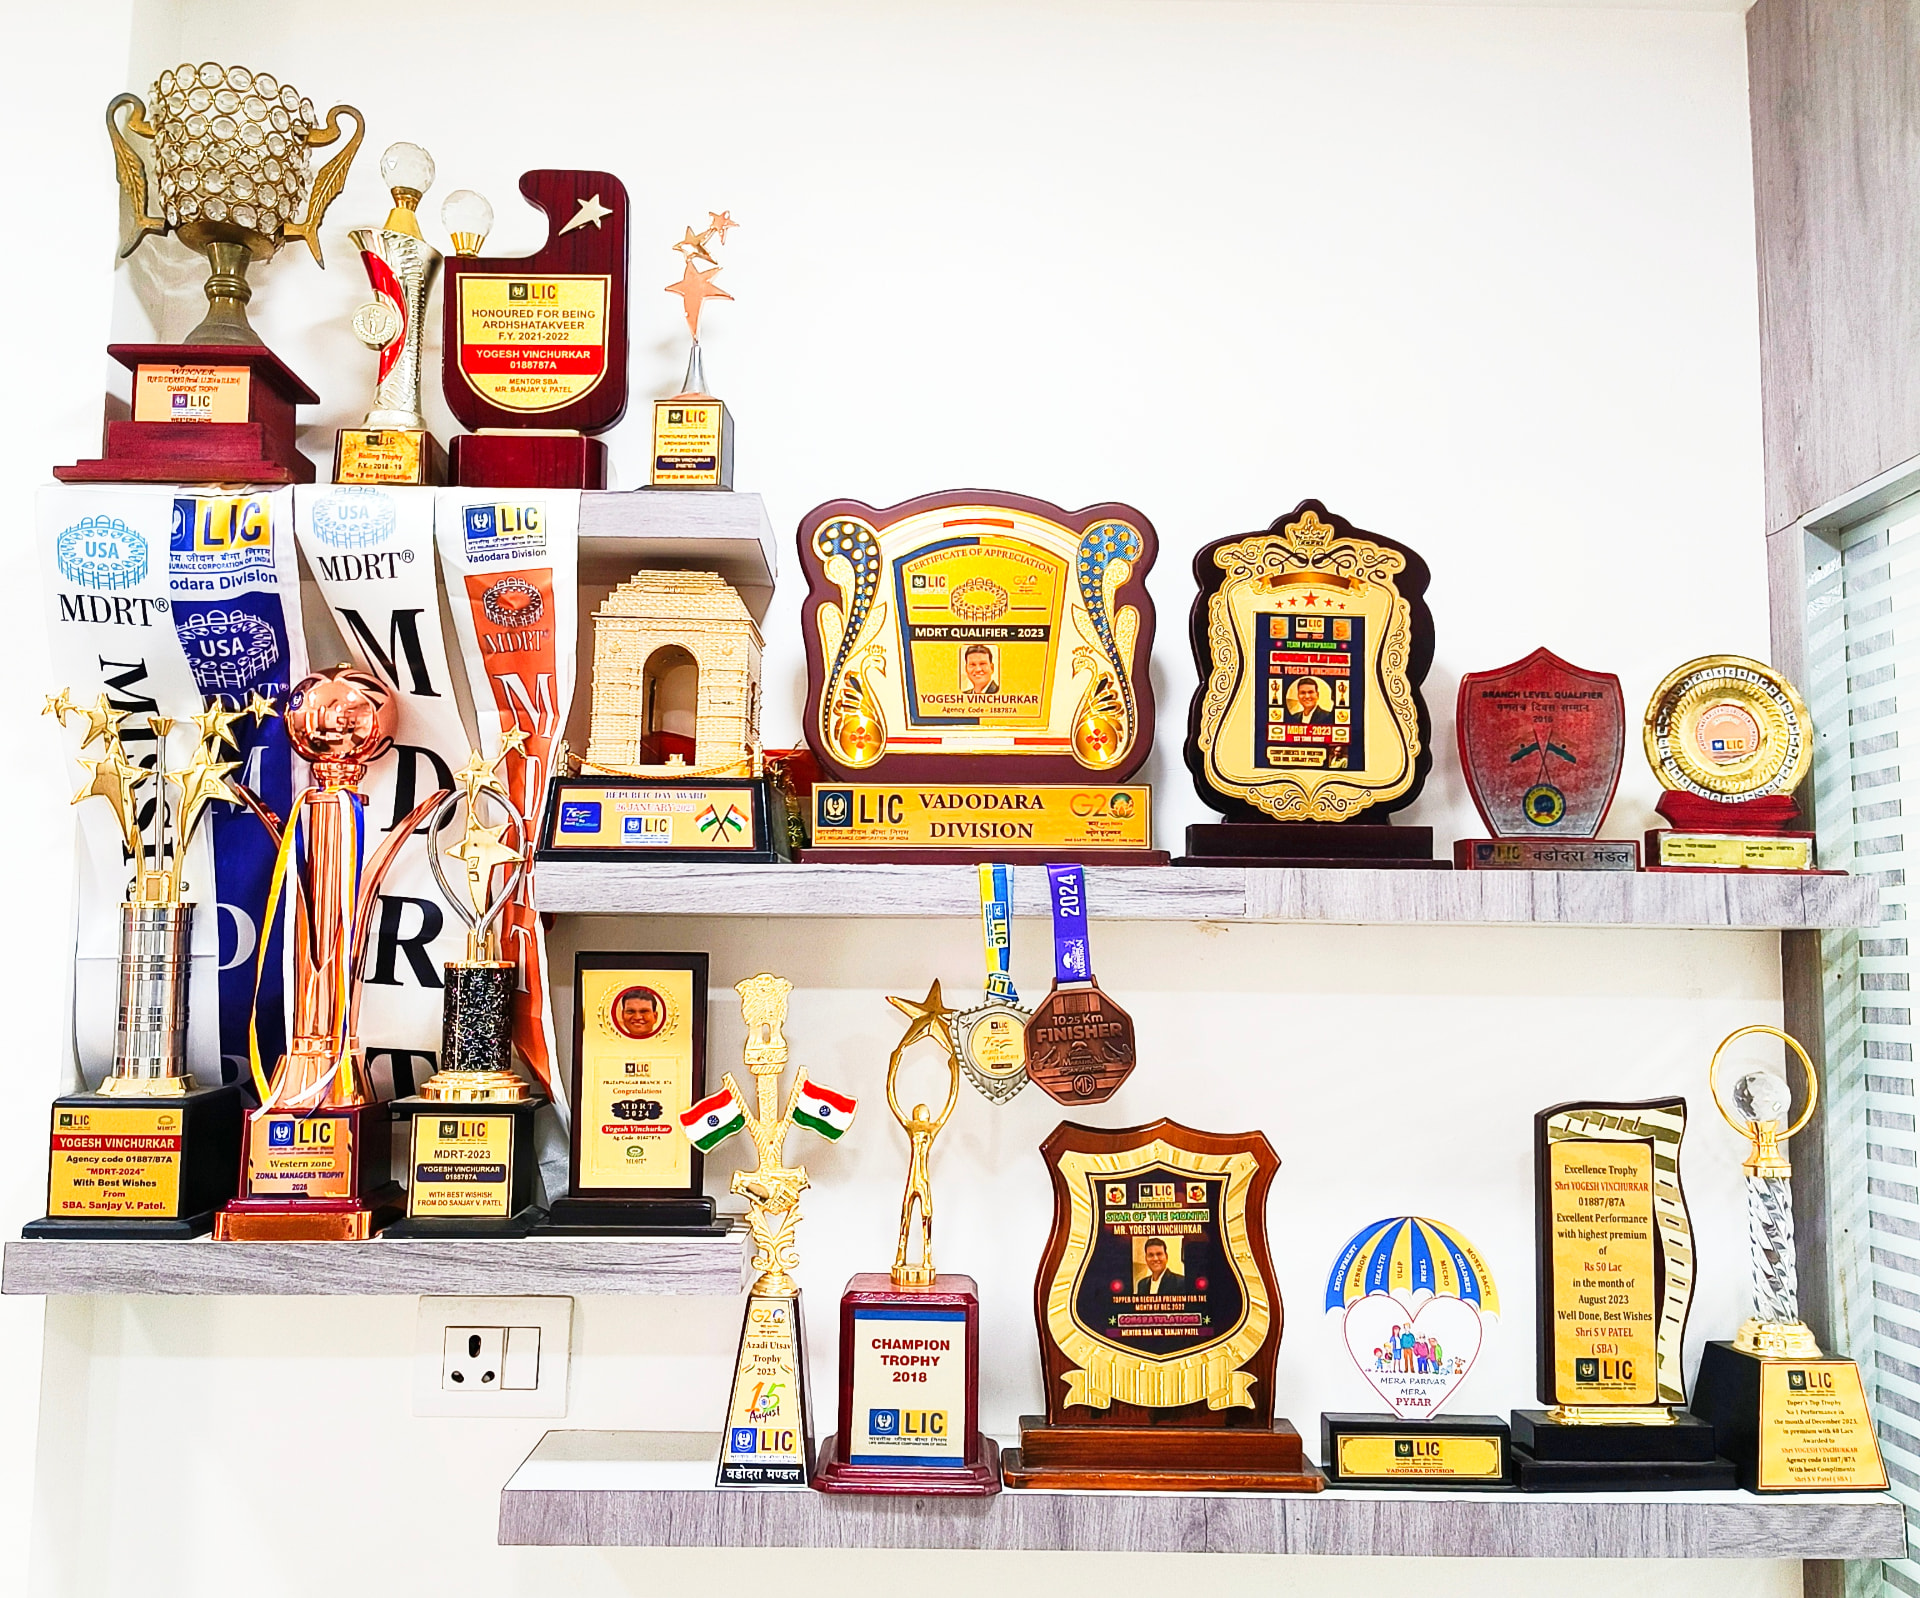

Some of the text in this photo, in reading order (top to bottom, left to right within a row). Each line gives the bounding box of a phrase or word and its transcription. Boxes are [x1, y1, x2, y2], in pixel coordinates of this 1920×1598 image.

[532, 285, 556, 299] LIC
[472, 309, 595, 319] HONOURED FOR BEING
[483, 320, 585, 329] ARDHSHATAKVEER
[499, 332, 569, 340] F.Y. 2021-2022
[477, 350, 590, 359] YOGESH VINCHURKAR
[510, 360, 557, 369] 0188787A
[190, 395, 210, 407] LIC
[686, 411, 705, 423] LIC
[338, 505, 369, 521] USA
[204, 502, 262, 545] LIC
[501, 507, 538, 532] LIC
[85, 541, 119, 560] USA
[186, 547, 271, 562] जीवन निगम
[466, 549, 547, 563] Vadodara Division
[907, 549, 1054, 576] CERTIFICATE APPRECIATION
[220, 569, 278, 590] Division
[928, 576, 946, 588] LIC
[1308, 619, 1322, 628] LIC
[915, 628, 1044, 639] MDRT QUALIFIER 2023
[201, 637, 245, 657] USA
[920, 694, 1039, 704] YOGESH VINCHURKAR
[1482, 691, 1604, 700] BRANCH LEVEL QUALIFIER
[1726, 740, 1744, 750] LIC
[918, 793, 1045, 810] VADODARA
[1070, 792, 1135, 819] G20
[860, 794, 904, 824] LIC
[645, 819, 667, 832] LIC
[930, 822, 1033, 839] DIVISION
[1494, 844, 1521, 860] LIC
[1533, 847, 1629, 863] वडोदरा मंडल
[1058, 874, 1080, 917] 2024
[994, 922, 1007, 945] LIC
[1082, 1013, 1104, 1024] Km
[1036, 1023, 1123, 1043] FINISHER
[637, 1064, 649, 1072] LIC
[1076, 1077, 1093, 1093] MG
[613, 1087, 662, 1096] Congratulations
[74, 1115, 90, 1125] LIC
[299, 1123, 331, 1144] LIC
[461, 1122, 486, 1137] LIC
[60, 1138, 175, 1149] YOGESH VINCHURKAR
[66, 1155, 99, 1163] Agency
[434, 1150, 491, 1159] MDRT-2023
[270, 1160, 308, 1168] Western
[1564, 1165, 1638, 1177] Excellence Trophy
[73, 1179, 157, 1187] With Best Wishes
[1571, 1181, 1649, 1191] YOGESH VINCHURKAR
[103, 1190, 126, 1198] From
[1155, 1185, 1172, 1196] LIC
[62, 1201, 122, 1211] SBA. Sanjay
[1578, 1197, 1625, 1208] 01887/87A
[1106, 1211, 1209, 1222] STAR THE MONTH
[1557, 1213, 1648, 1223] Excellent Performance
[1129, 1224, 1202, 1235] YOGESH VINCHURKAR
[1558, 1229, 1647, 1241] with highest premium
[1333, 1244, 1359, 1292] ENDOWMENT
[1353, 1254, 1368, 1288] PENSION
[1374, 1253, 1386, 1285] HEALTH
[1419, 1258, 1427, 1283] TERM
[1454, 1253, 1472, 1294] CHILDREN
[1466, 1247, 1492, 1297] MONEY BACK
[1598, 1278, 1625, 1288] month
[1578, 1294, 1629, 1306] August 2023
[751, 1309, 785, 1324] G20
[1120, 1315, 1199, 1324] CONGRATULATIONS
[1557, 1310, 1653, 1321] Well Done, Best Wishes
[1575, 1327, 1633, 1337] Shri PATEL
[746, 1340, 792, 1350] Azadi Utsav
[872, 1339, 950, 1351] CHAMPION
[753, 1354, 781, 1364] Trophy
[881, 1355, 940, 1366] TROPHY
[757, 1367, 777, 1376] 2023
[1603, 1360, 1633, 1380] LIC
[893, 1372, 927, 1382] 2018
[1380, 1377, 1447, 1386] MERA PARIVAR
[1809, 1372, 1832, 1388] LIC
[1400, 1387, 1427, 1396] MERA
[1396, 1397, 1432, 1407] PYAAR
[749, 1407, 780, 1424] August
[905, 1412, 943, 1434] LIC
[761, 1431, 794, 1451] LIC
[1416, 1441, 1440, 1456] LIC
[726, 1465, 801, 1481] वडोदरा मण्डल
